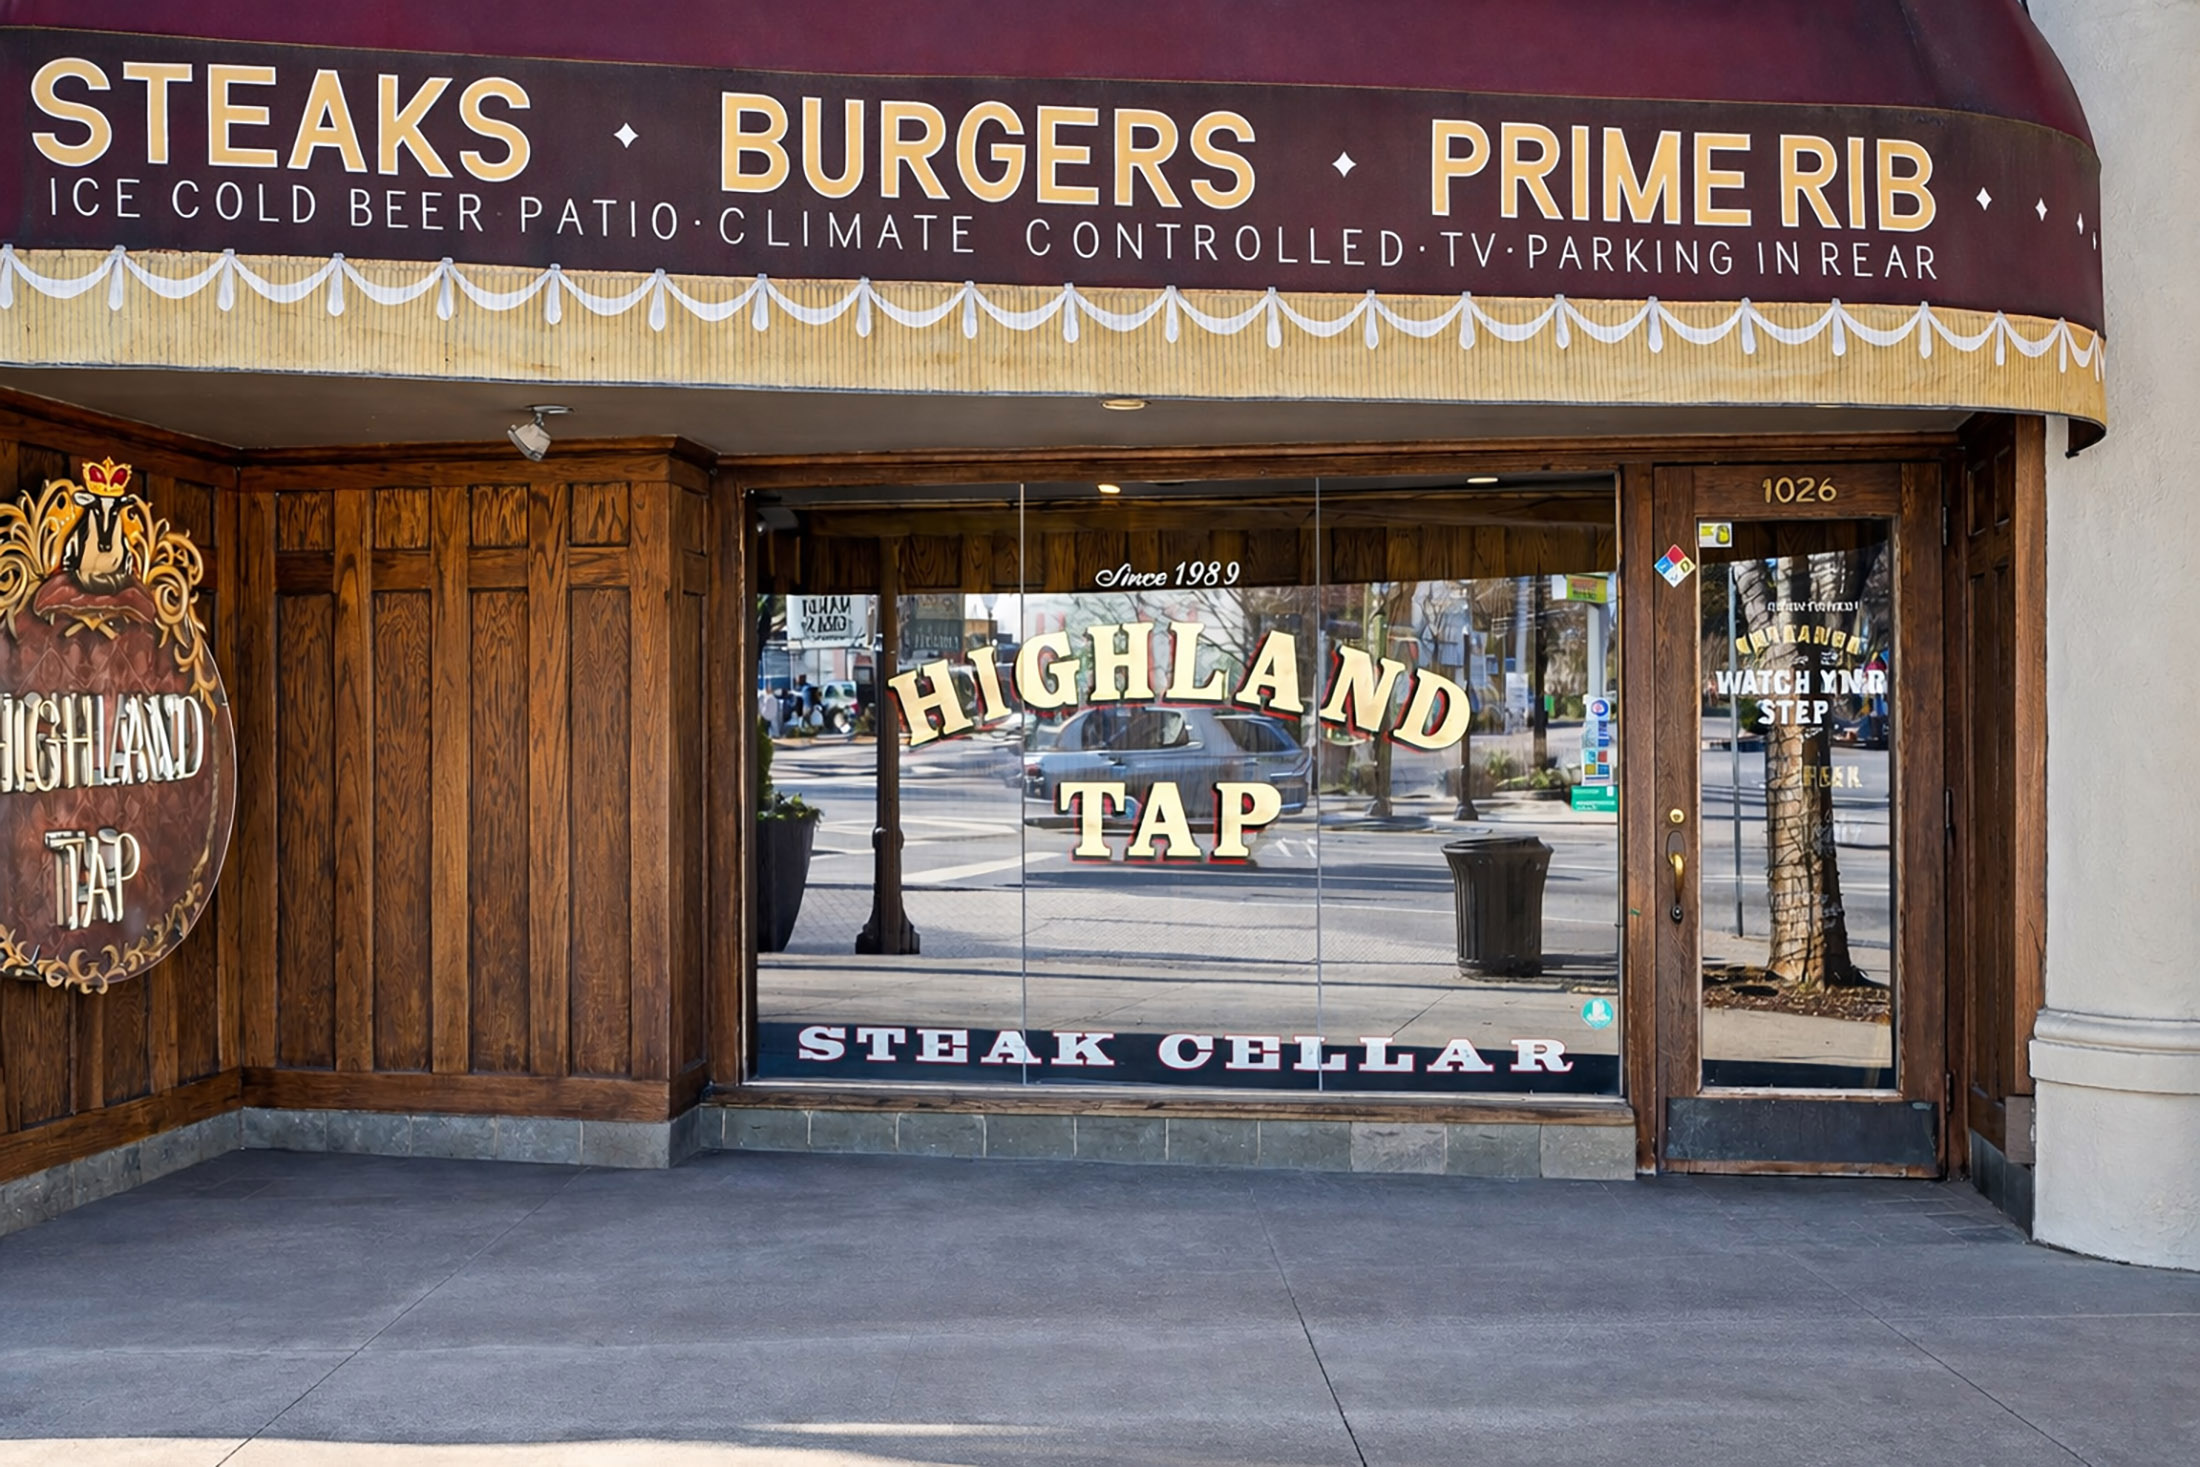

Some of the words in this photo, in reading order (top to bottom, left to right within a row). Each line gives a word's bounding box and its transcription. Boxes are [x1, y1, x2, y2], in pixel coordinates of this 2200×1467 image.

[31, 57, 531, 182] STEAKS
[721, 91, 1256, 209] BURGERS
[1431, 118, 1753, 228] PRIME
[1779, 133, 1937, 232] RIB
[50, 177, 141, 218] ICE
[172, 180, 316, 223] COLD
[350, 188, 483, 232] BEER
[520, 196, 678, 240] PATIO
[719, 207, 974, 253] CLIMATE
[1026, 218, 1403, 267] CONTROLLED
[1439, 231, 1496, 268] TV
[1528, 234, 1733, 275] PARKING
[1757, 240, 1799, 275] IN
[1820, 241, 1937, 280] REAR
[1763, 477, 1838, 503] 1026
[1094, 562, 1168, 588] Since
[1174, 560, 1241, 587] 1989
[887, 622, 1471, 752] HIGHLAND
[1716, 669, 1811, 695] WATCH
[1758, 699, 1829, 725] STEP
[1057, 781, 1282, 862] TAP
[44, 828, 141, 930] TAP
[799, 1026, 1115, 1066] STEAK
[1158, 1033, 1574, 1073] CELLAR
